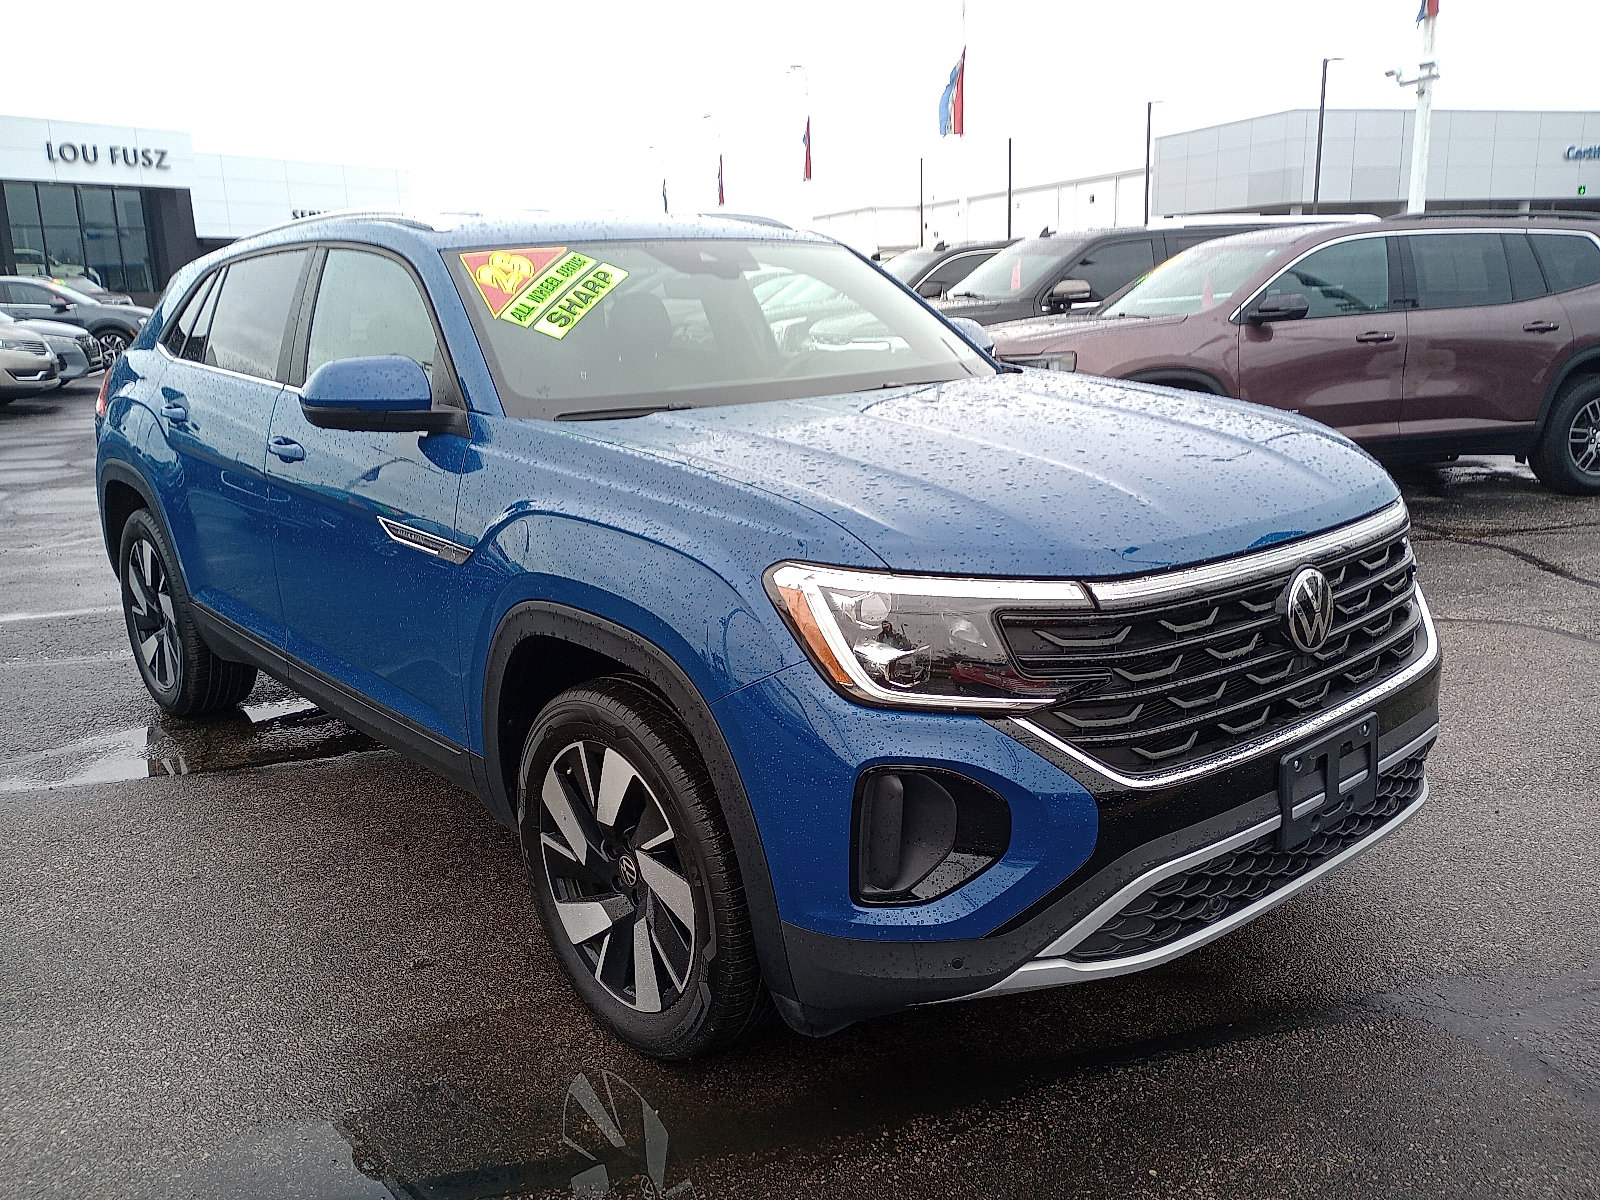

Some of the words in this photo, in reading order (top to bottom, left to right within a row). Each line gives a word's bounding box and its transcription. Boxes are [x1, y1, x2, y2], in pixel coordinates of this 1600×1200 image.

[46, 141, 99, 165] LOU
[109, 145, 171, 170] FUSZ
[510, 302, 537, 322] ALL
[526, 275, 564, 304] WHEEL
[556, 252, 588, 278] DRIVE
[546, 270, 613, 327] SHARP
